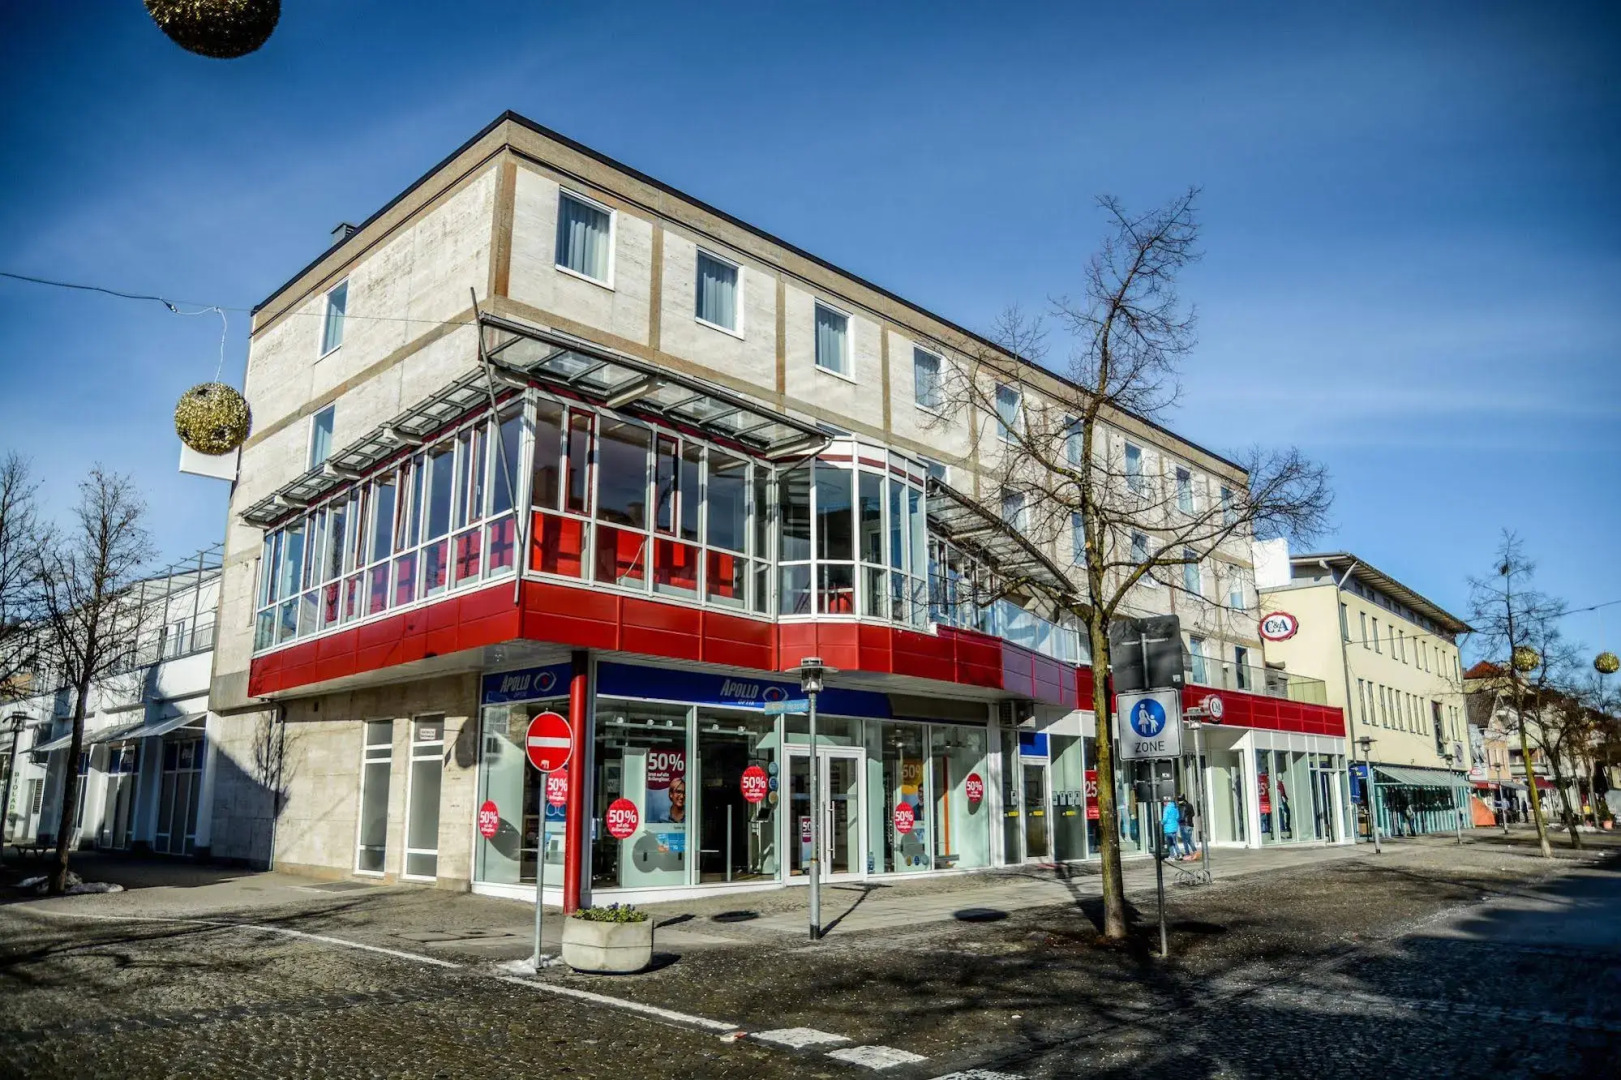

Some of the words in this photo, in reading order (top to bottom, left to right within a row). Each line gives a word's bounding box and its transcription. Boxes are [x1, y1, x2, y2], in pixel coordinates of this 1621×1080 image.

[1264, 619, 1289, 634] C&A
[500, 674, 531, 693] APOLLO
[720, 679, 760, 699] APOLLO
[1135, 740, 1166, 753] ZONE
[648, 753, 685, 771] 50%
[547, 778, 568, 792] 50%
[743, 776, 766, 789] 50%
[966, 781, 983, 792] 50%
[480, 811, 498, 824] 50%
[608, 810, 637, 824] 50%
[895, 810, 915, 823] 50%
